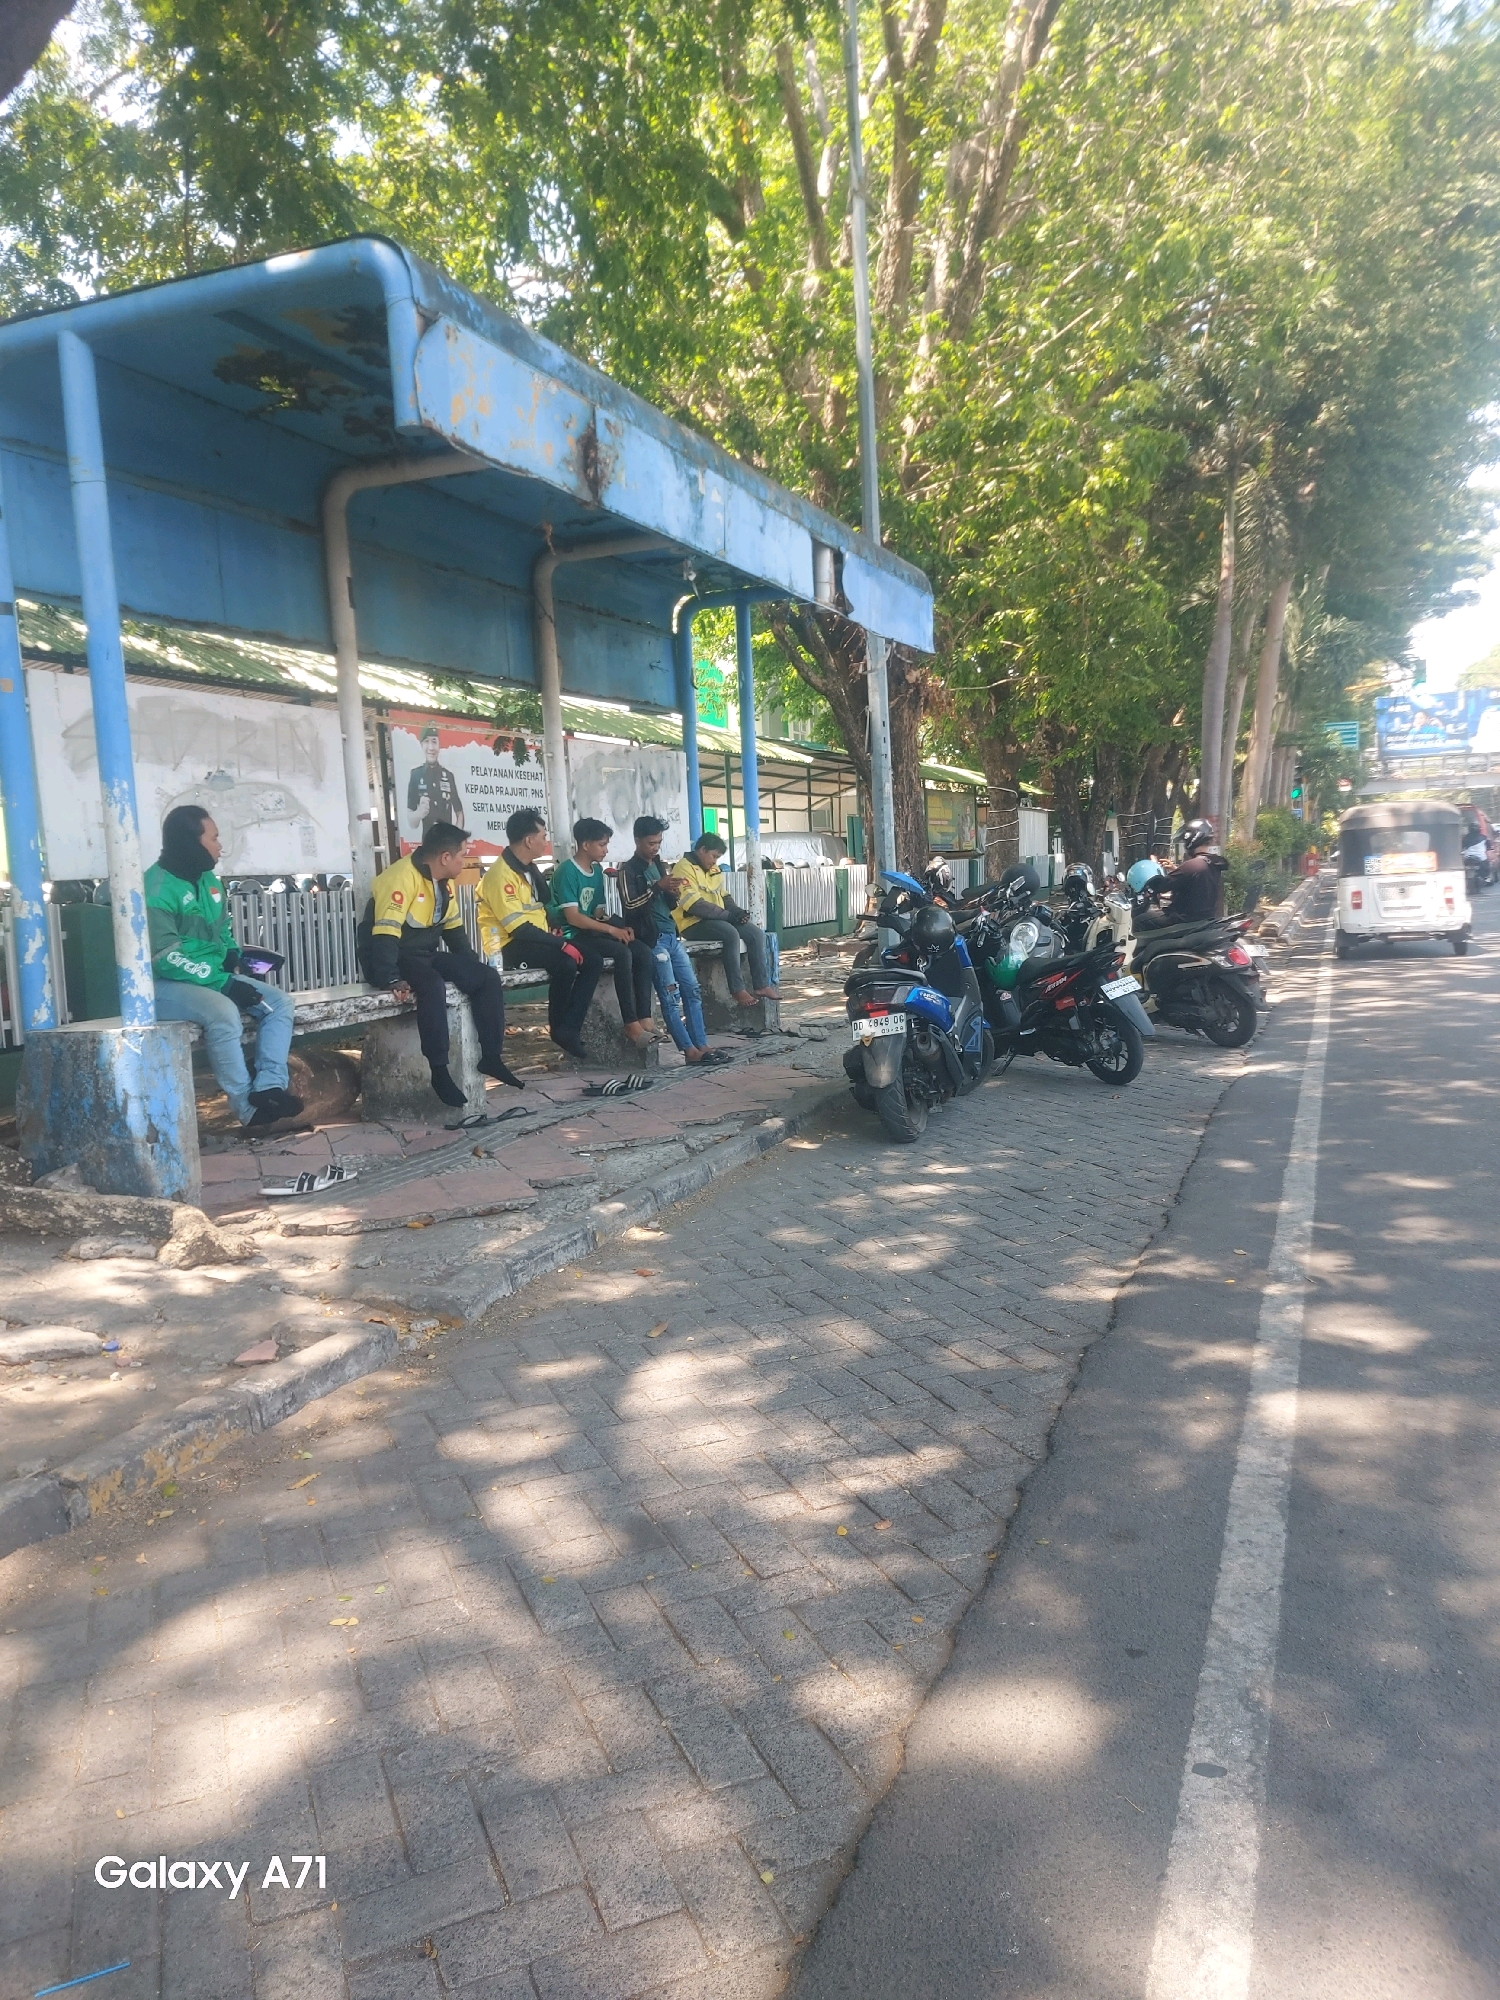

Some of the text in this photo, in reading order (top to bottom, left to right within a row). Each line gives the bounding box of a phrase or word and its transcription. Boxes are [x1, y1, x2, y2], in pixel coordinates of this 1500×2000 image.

[471, 766, 545, 782] PELAYANAN KESEHAT
[465, 783, 494, 796] KEPADA
[531, 788, 544, 798] PNS
[472, 802, 494, 813] SERTA
[167, 951, 211, 979] Grab
[853, 1021, 864, 1032] DD
